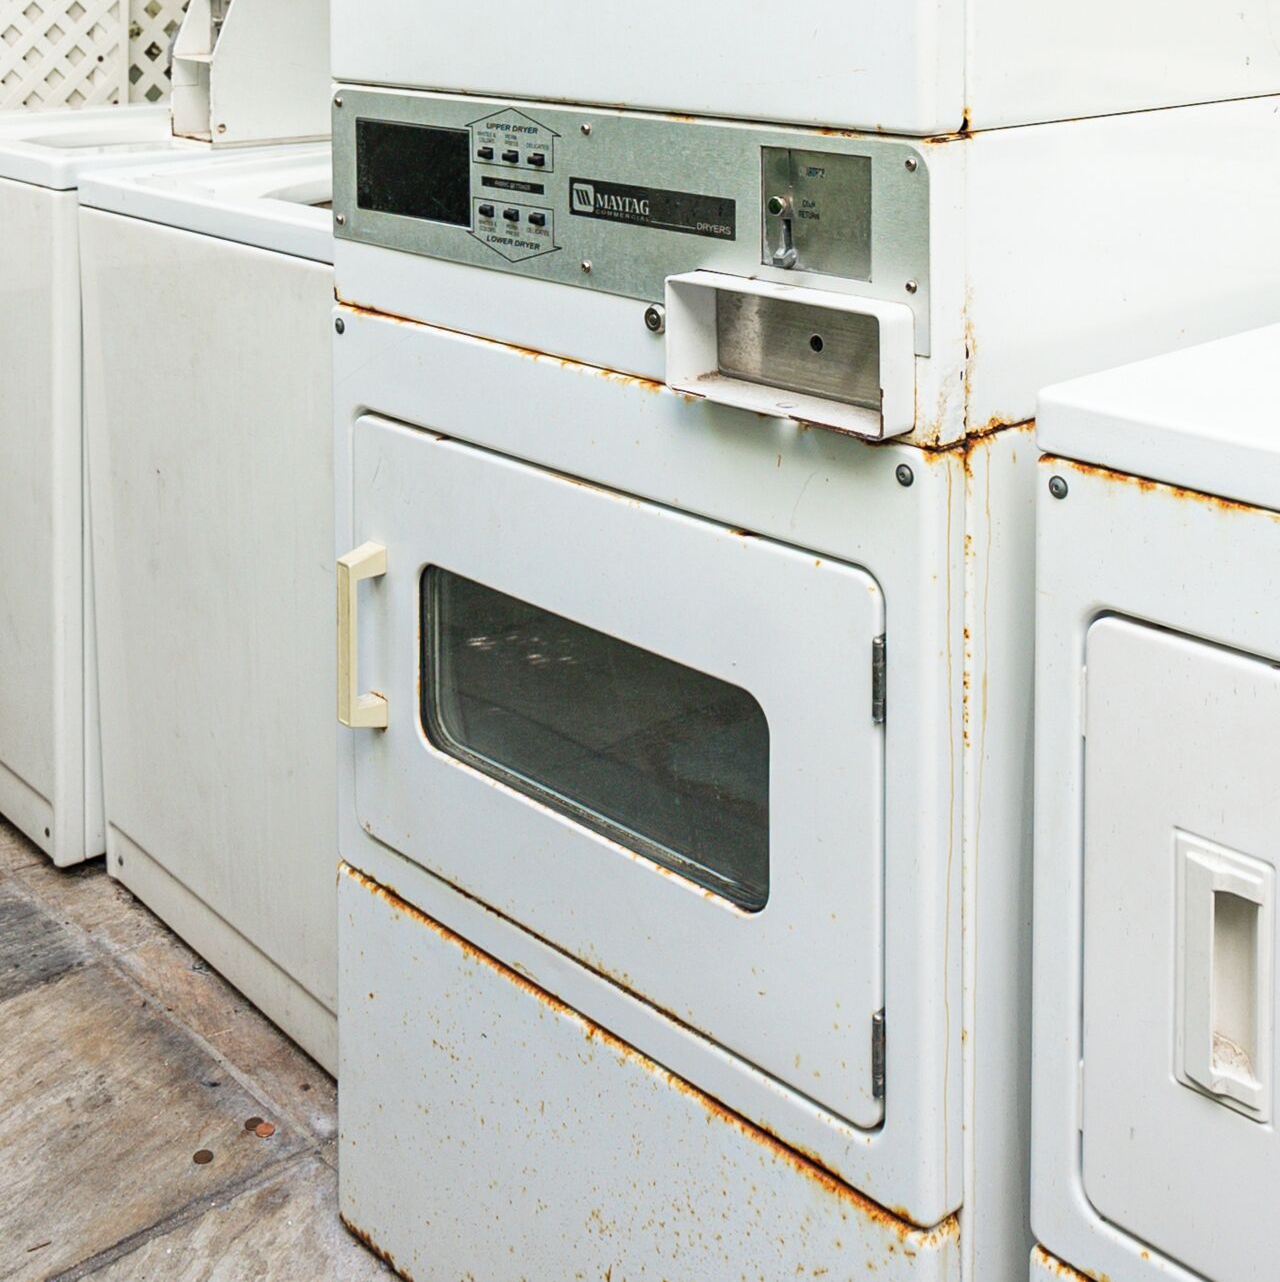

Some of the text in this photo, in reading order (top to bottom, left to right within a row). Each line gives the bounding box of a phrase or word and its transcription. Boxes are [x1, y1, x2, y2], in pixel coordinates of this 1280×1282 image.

[486, 122, 538, 135] UPPER DRYER
[596, 193, 650, 215] MAYTAG
[595, 208, 732, 236] COMMERCIAL DRYERS
[486, 235, 541, 250] LOWER DRYER
